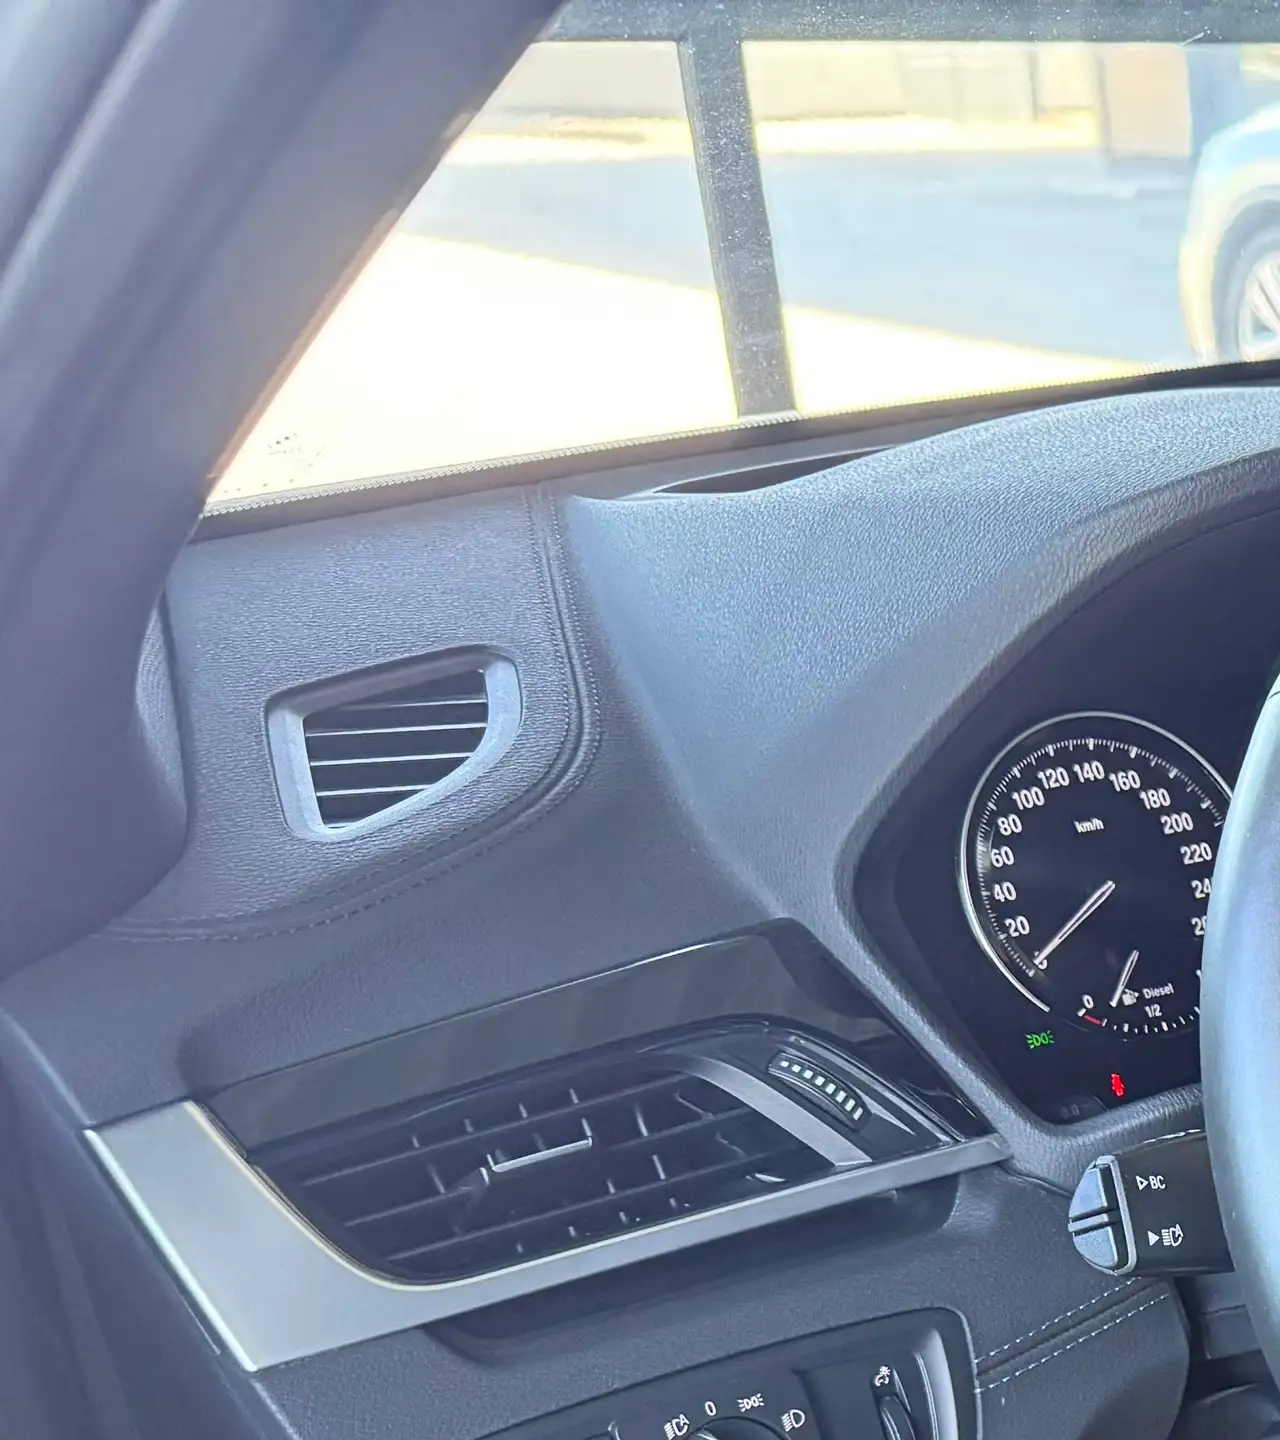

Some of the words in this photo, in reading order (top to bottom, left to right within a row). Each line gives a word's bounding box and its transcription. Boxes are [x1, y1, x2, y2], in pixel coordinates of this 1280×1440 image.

[1036, 766, 1070, 790] 120
[1073, 760, 1105, 783] 140
[1108, 769, 1141, 792] 160
[1011, 786, 1045, 811] 100
[1139, 787, 1171, 810] 180
[997, 813, 1023, 836] 80
[1074, 817, 1104, 833] km/h
[1160, 811, 1194, 835] 200
[990, 845, 1015, 868] 60
[1180, 842, 1213, 865] 220
[993, 881, 1017, 903] 40
[1190, 877, 1212, 899] 24
[1004, 915, 1030, 938] 20
[1082, 994, 1094, 1009] 0
[1143, 982, 1175, 1000] Diesel
[1144, 1004, 1163, 1019] 1/2
[1149, 1175, 1166, 1190] BC
